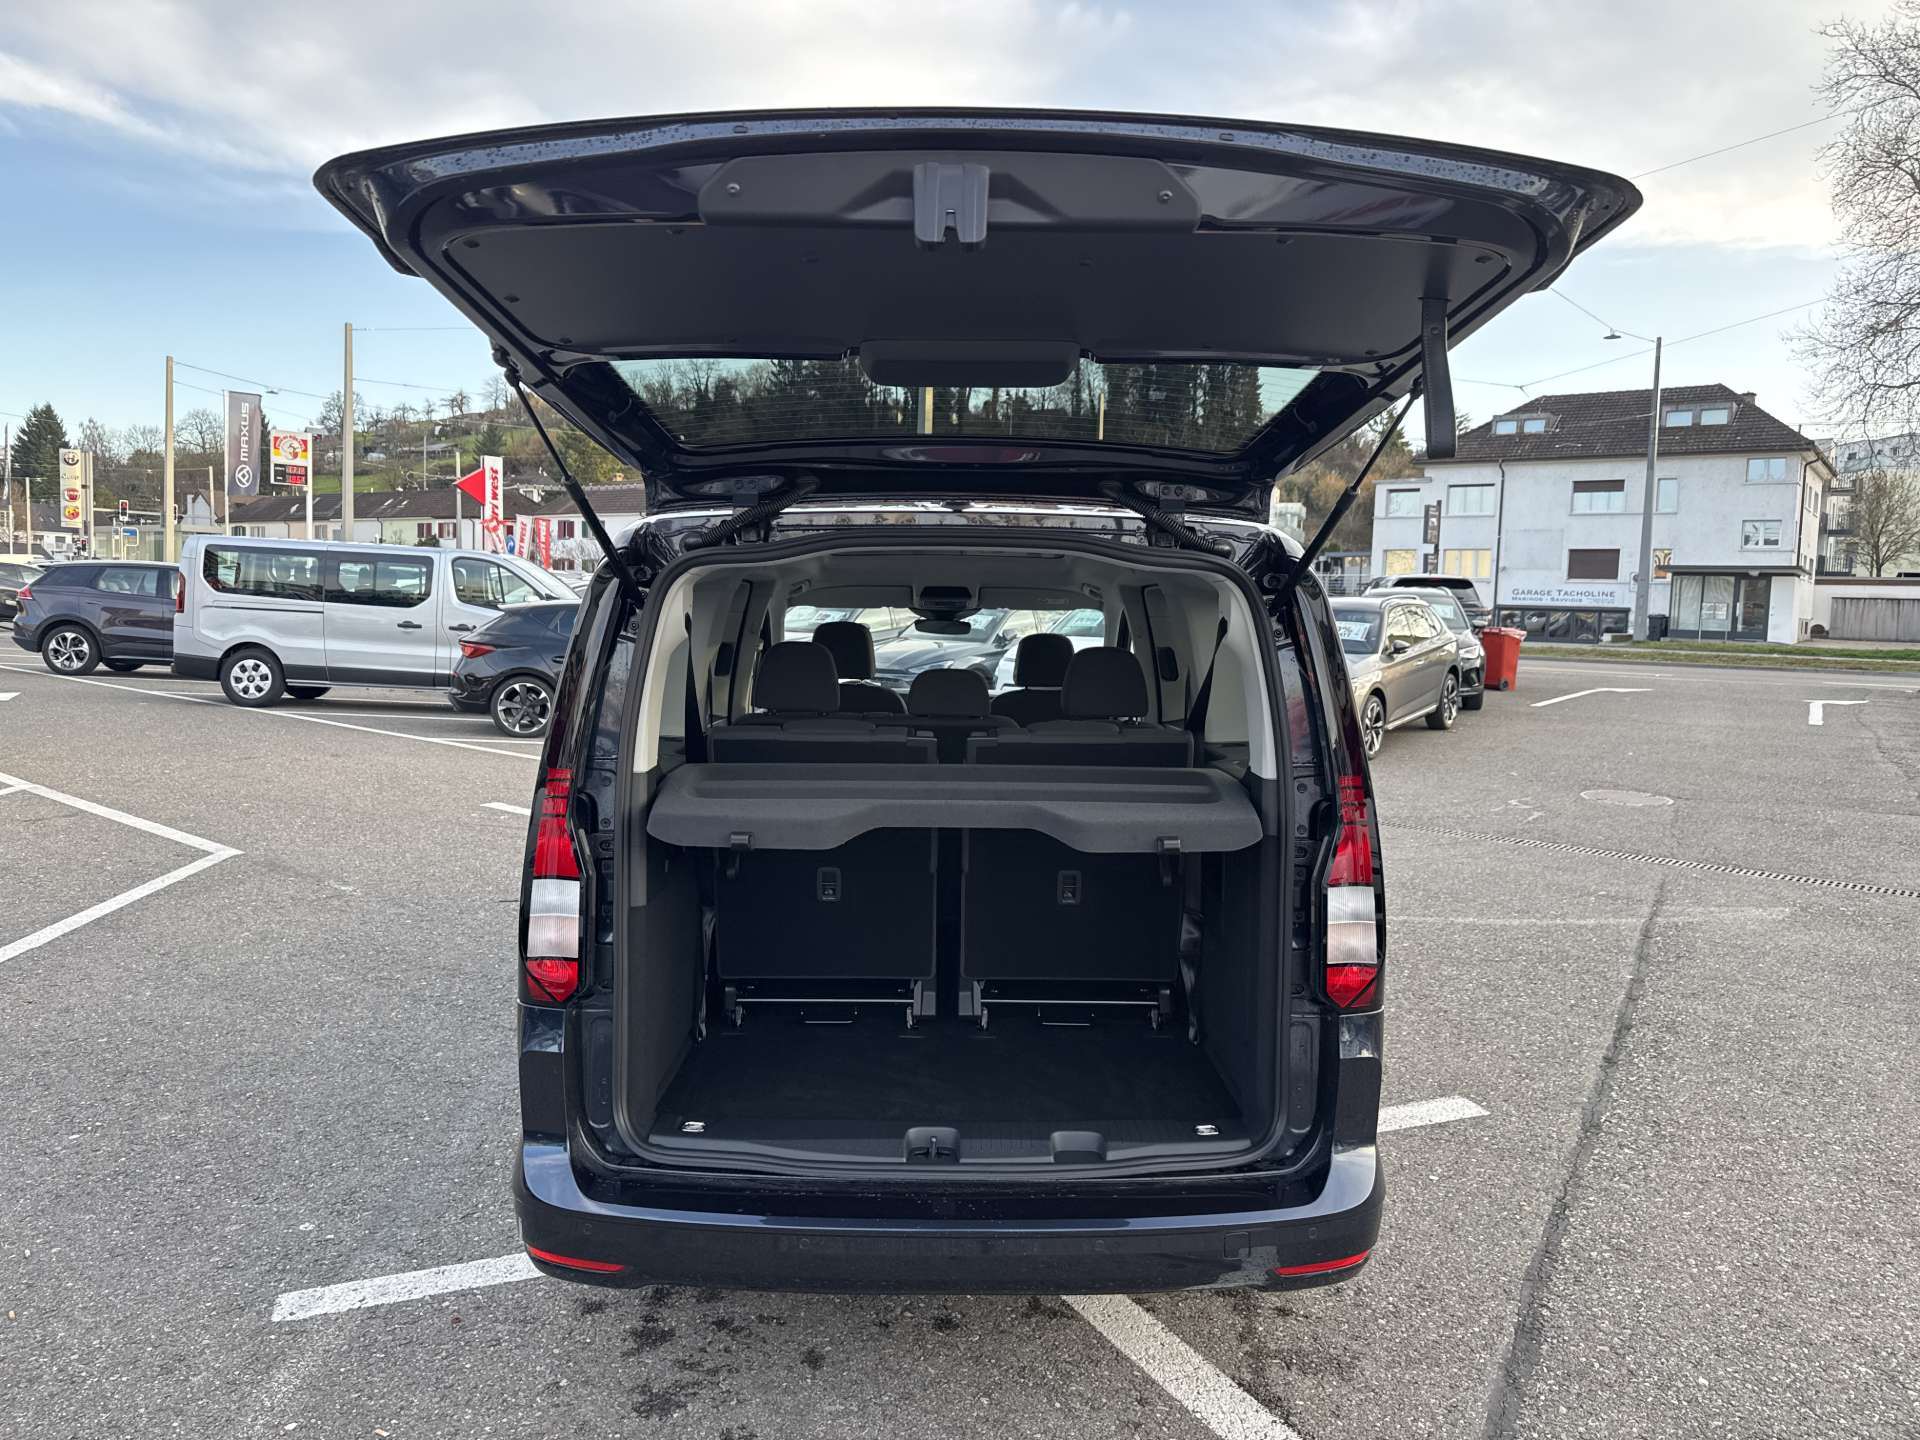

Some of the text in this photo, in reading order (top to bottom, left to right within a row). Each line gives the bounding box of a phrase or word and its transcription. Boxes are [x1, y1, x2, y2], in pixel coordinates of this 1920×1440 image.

[240, 402, 249, 462] MAXUS
[490, 467, 499, 501] west
[1511, 588, 1616, 598] GARAGE TACHOLINE
